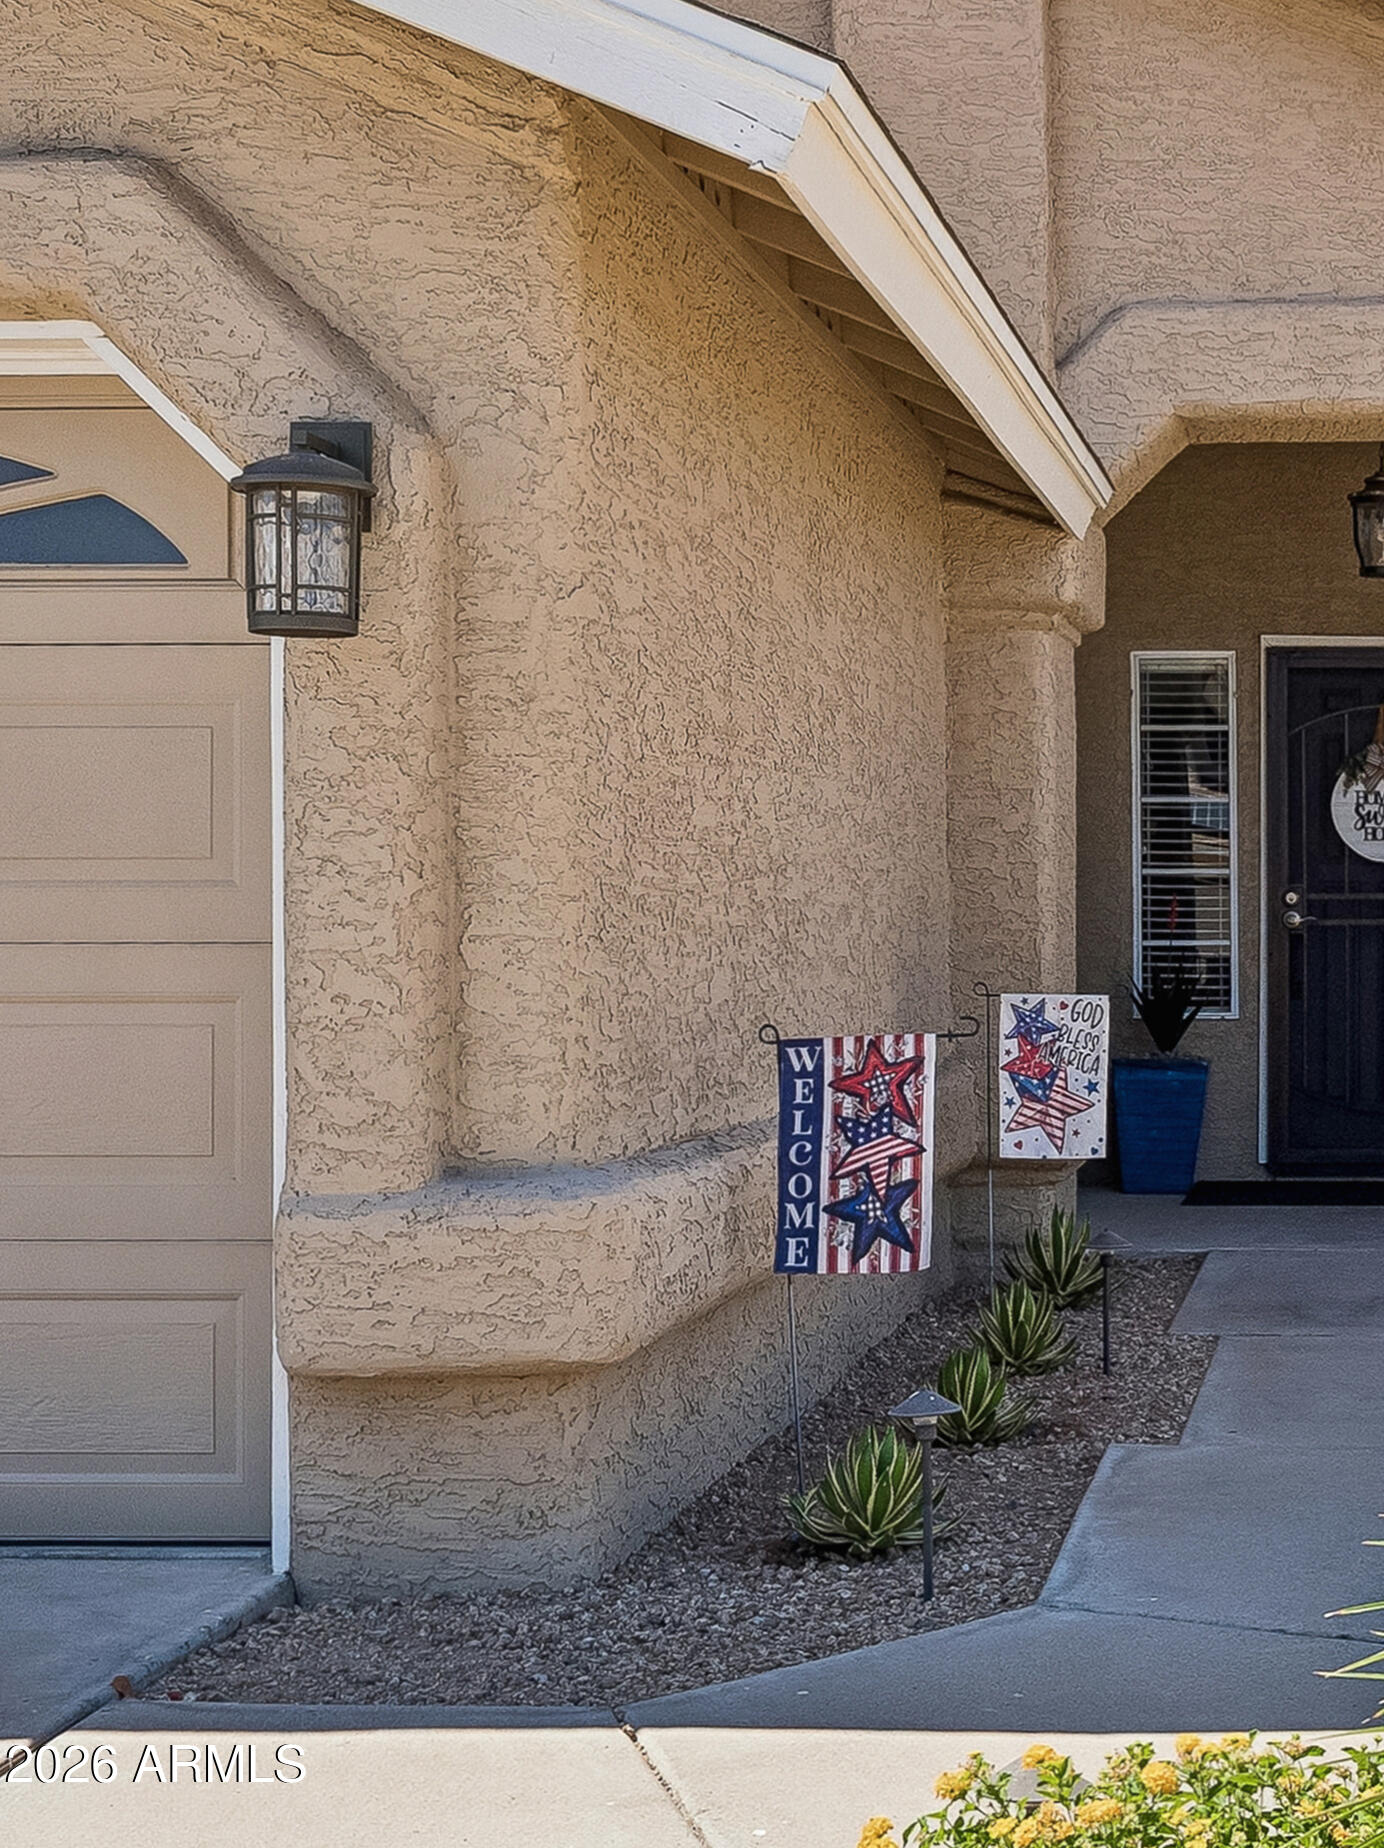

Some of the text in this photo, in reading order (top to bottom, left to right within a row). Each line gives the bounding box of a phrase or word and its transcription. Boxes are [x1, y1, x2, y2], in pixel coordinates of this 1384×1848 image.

[1070, 998, 1104, 1029] GOD
[1056, 1023, 1100, 1053] BLESS
[1036, 1040, 1101, 1076] AMERICA
[784, 1046, 822, 1267] WELCOME
